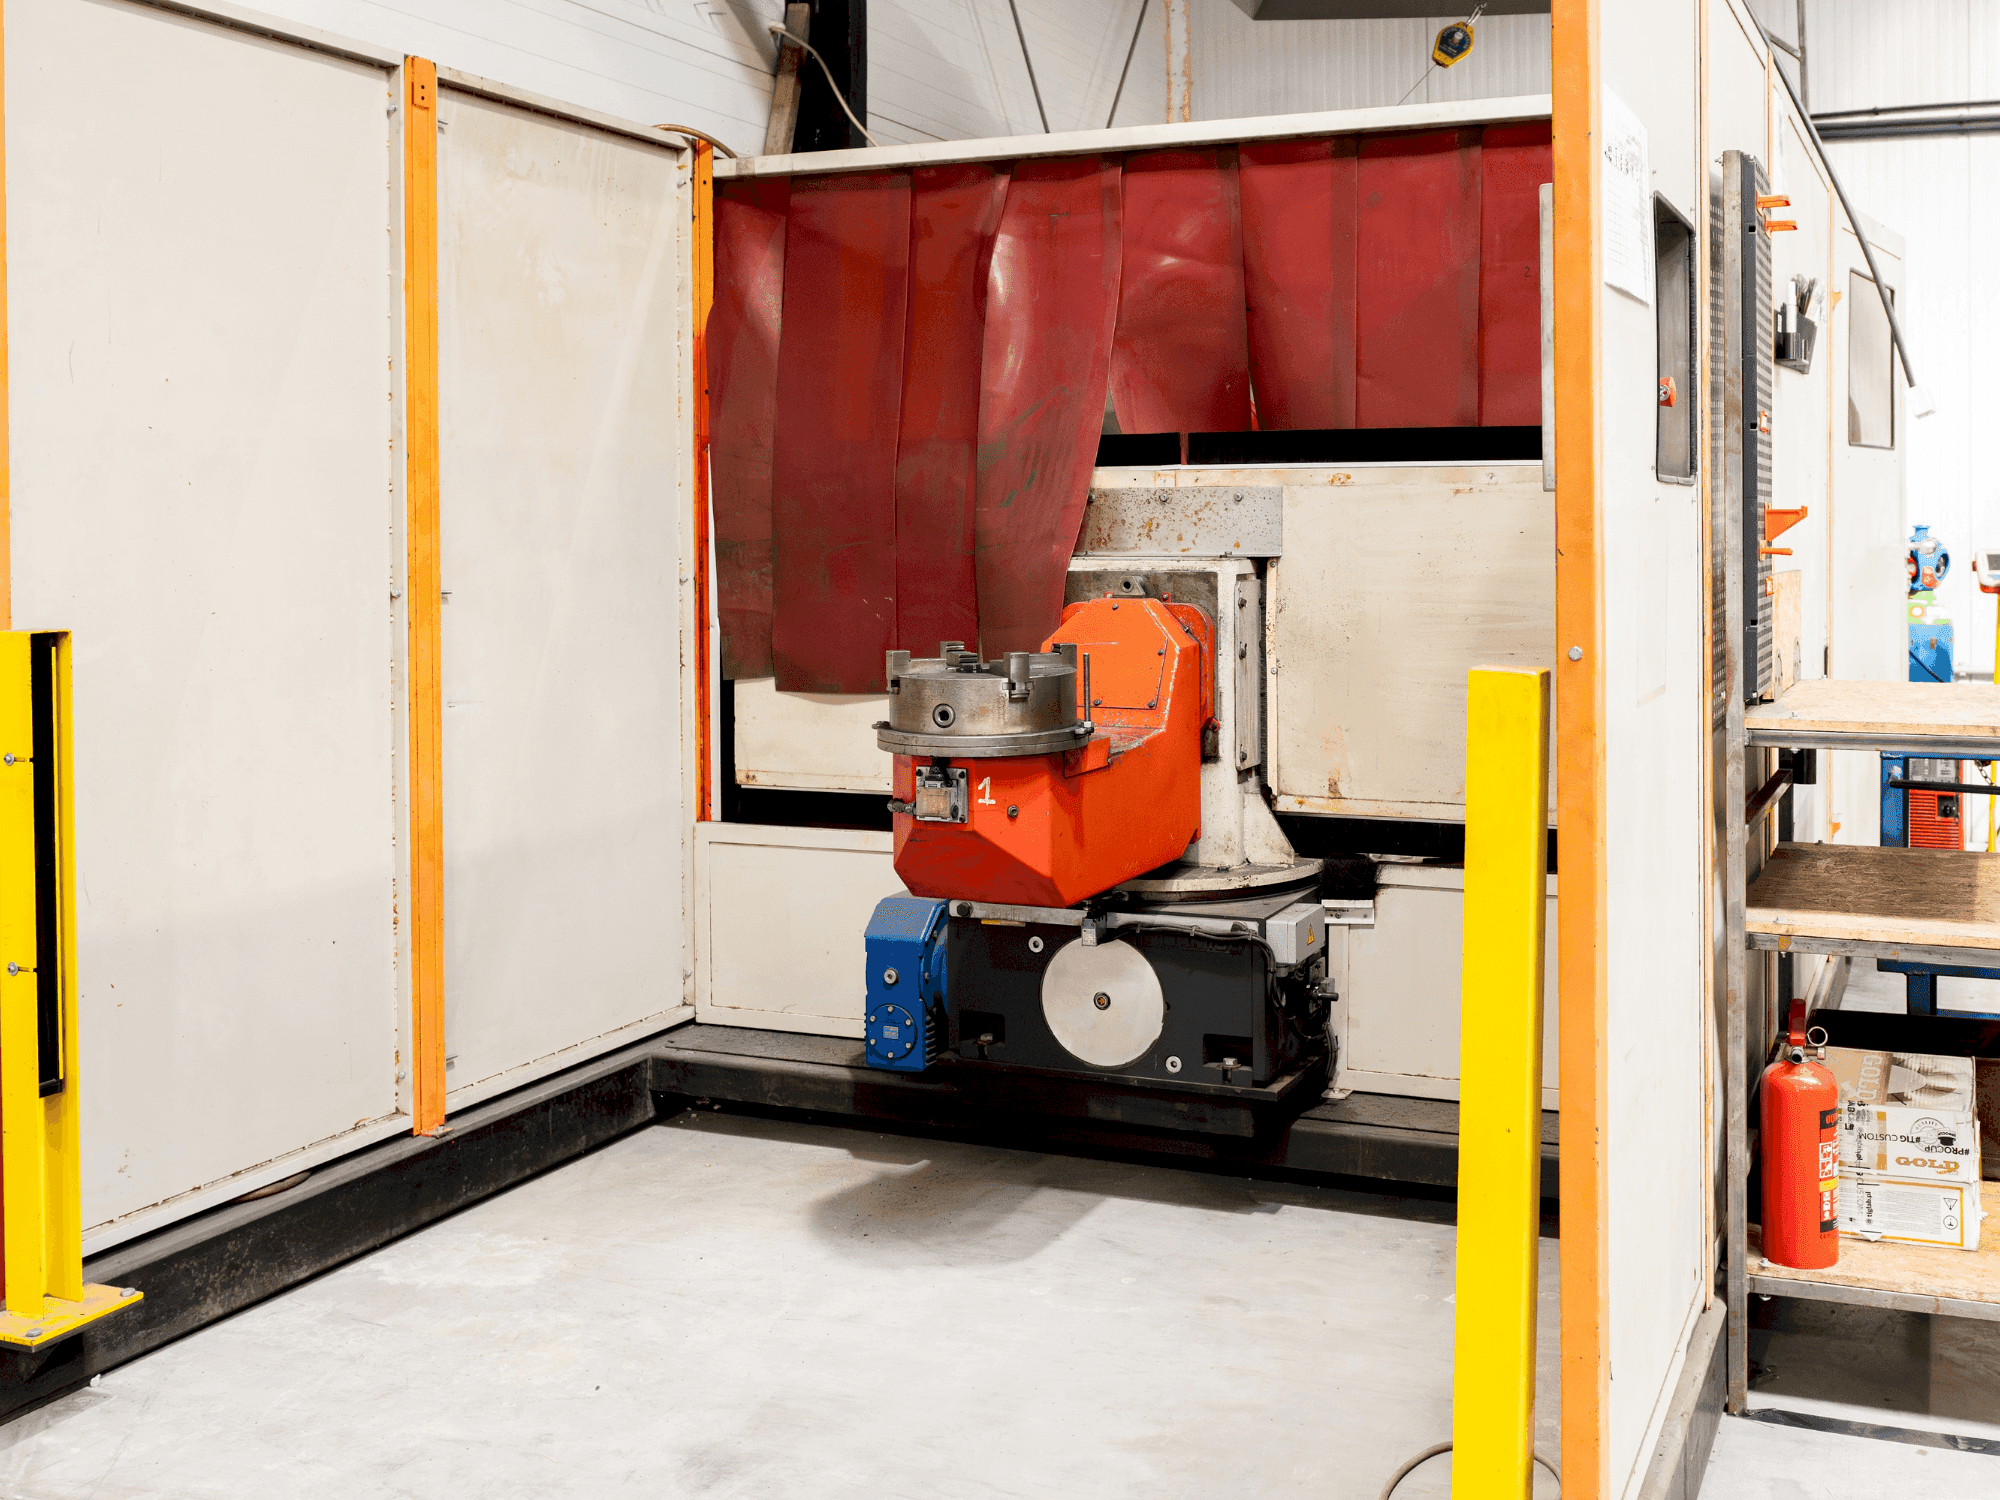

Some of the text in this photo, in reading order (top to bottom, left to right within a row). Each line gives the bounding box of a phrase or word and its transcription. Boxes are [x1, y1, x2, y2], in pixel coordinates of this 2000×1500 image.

[977, 776, 997, 806] 1
[1857, 1055, 1883, 1101] GOLD
[1858, 1132, 1921, 1144] #TIG CUSTOM
[1924, 1144, 1970, 1156] #PROCUP
[1895, 1156, 1960, 1172] GOLD
